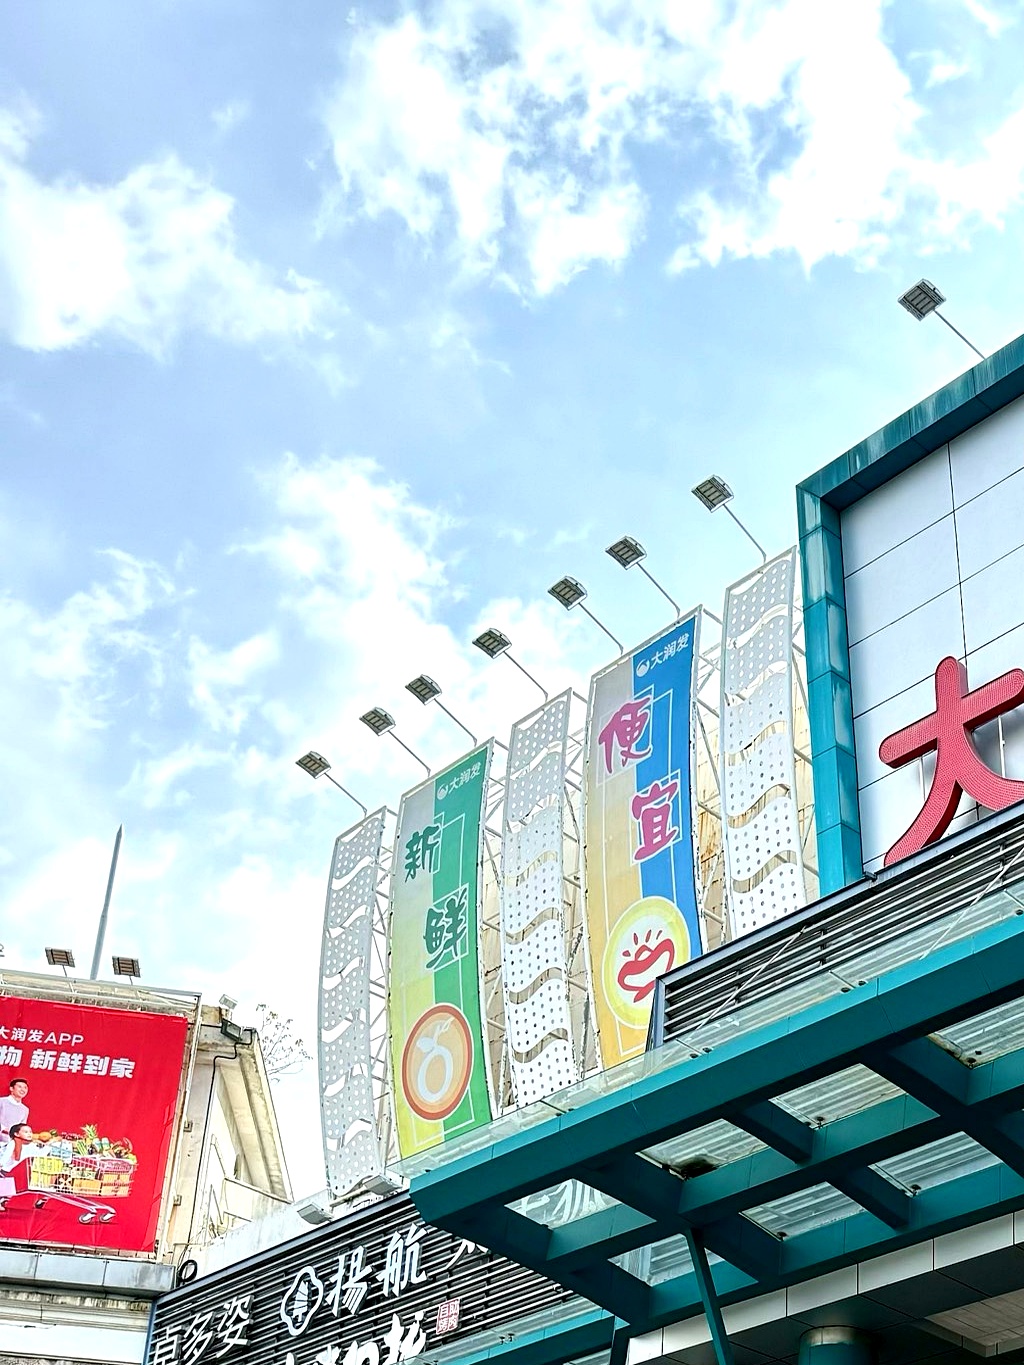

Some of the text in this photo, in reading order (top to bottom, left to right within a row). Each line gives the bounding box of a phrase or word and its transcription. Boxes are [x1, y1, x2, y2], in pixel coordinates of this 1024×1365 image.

[650, 633, 690, 671] 大润发
[449, 760, 481, 795] 大润发
[598, 697, 680, 863] 便宜
[404, 823, 470, 970] 新鲜
[29, 1048, 136, 1079] 新鲜到家
